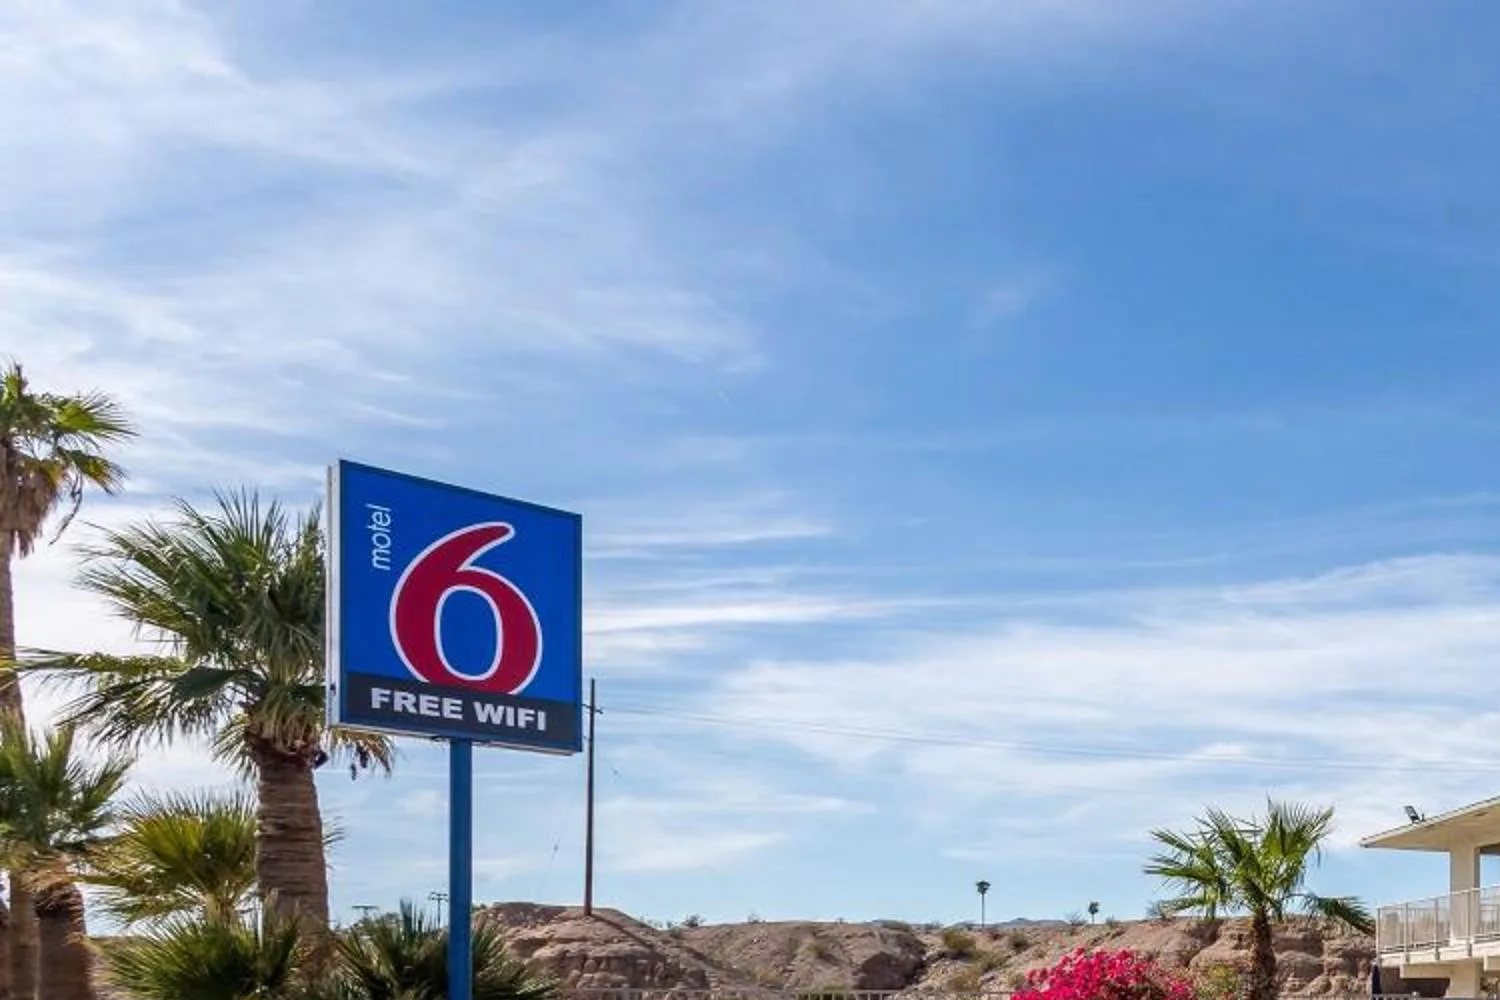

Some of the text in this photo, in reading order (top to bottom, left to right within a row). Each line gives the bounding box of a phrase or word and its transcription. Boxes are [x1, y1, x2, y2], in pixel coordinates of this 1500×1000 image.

[365, 503, 392, 571] motel
[389, 521, 543, 696] 6
[370, 687, 547, 731] FREE WIFI
